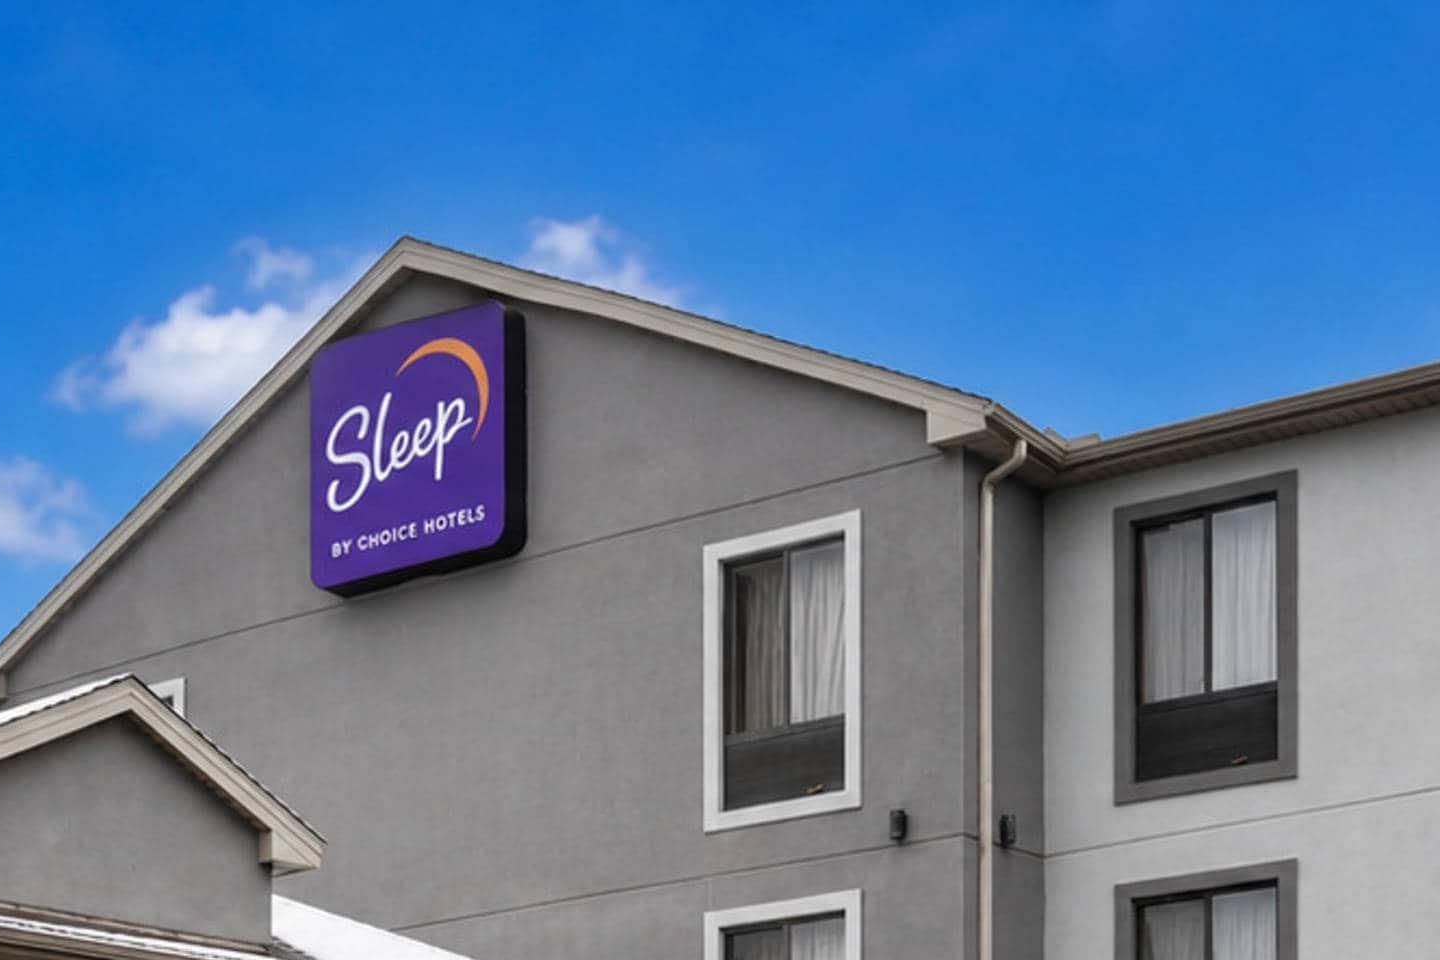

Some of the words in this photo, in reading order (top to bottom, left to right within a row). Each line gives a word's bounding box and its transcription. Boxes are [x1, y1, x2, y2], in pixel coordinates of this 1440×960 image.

[325, 391, 474, 513] Sleep
[331, 539, 352, 558] BY
[357, 522, 417, 551] CHOICE
[423, 504, 486, 535] HOTELS
